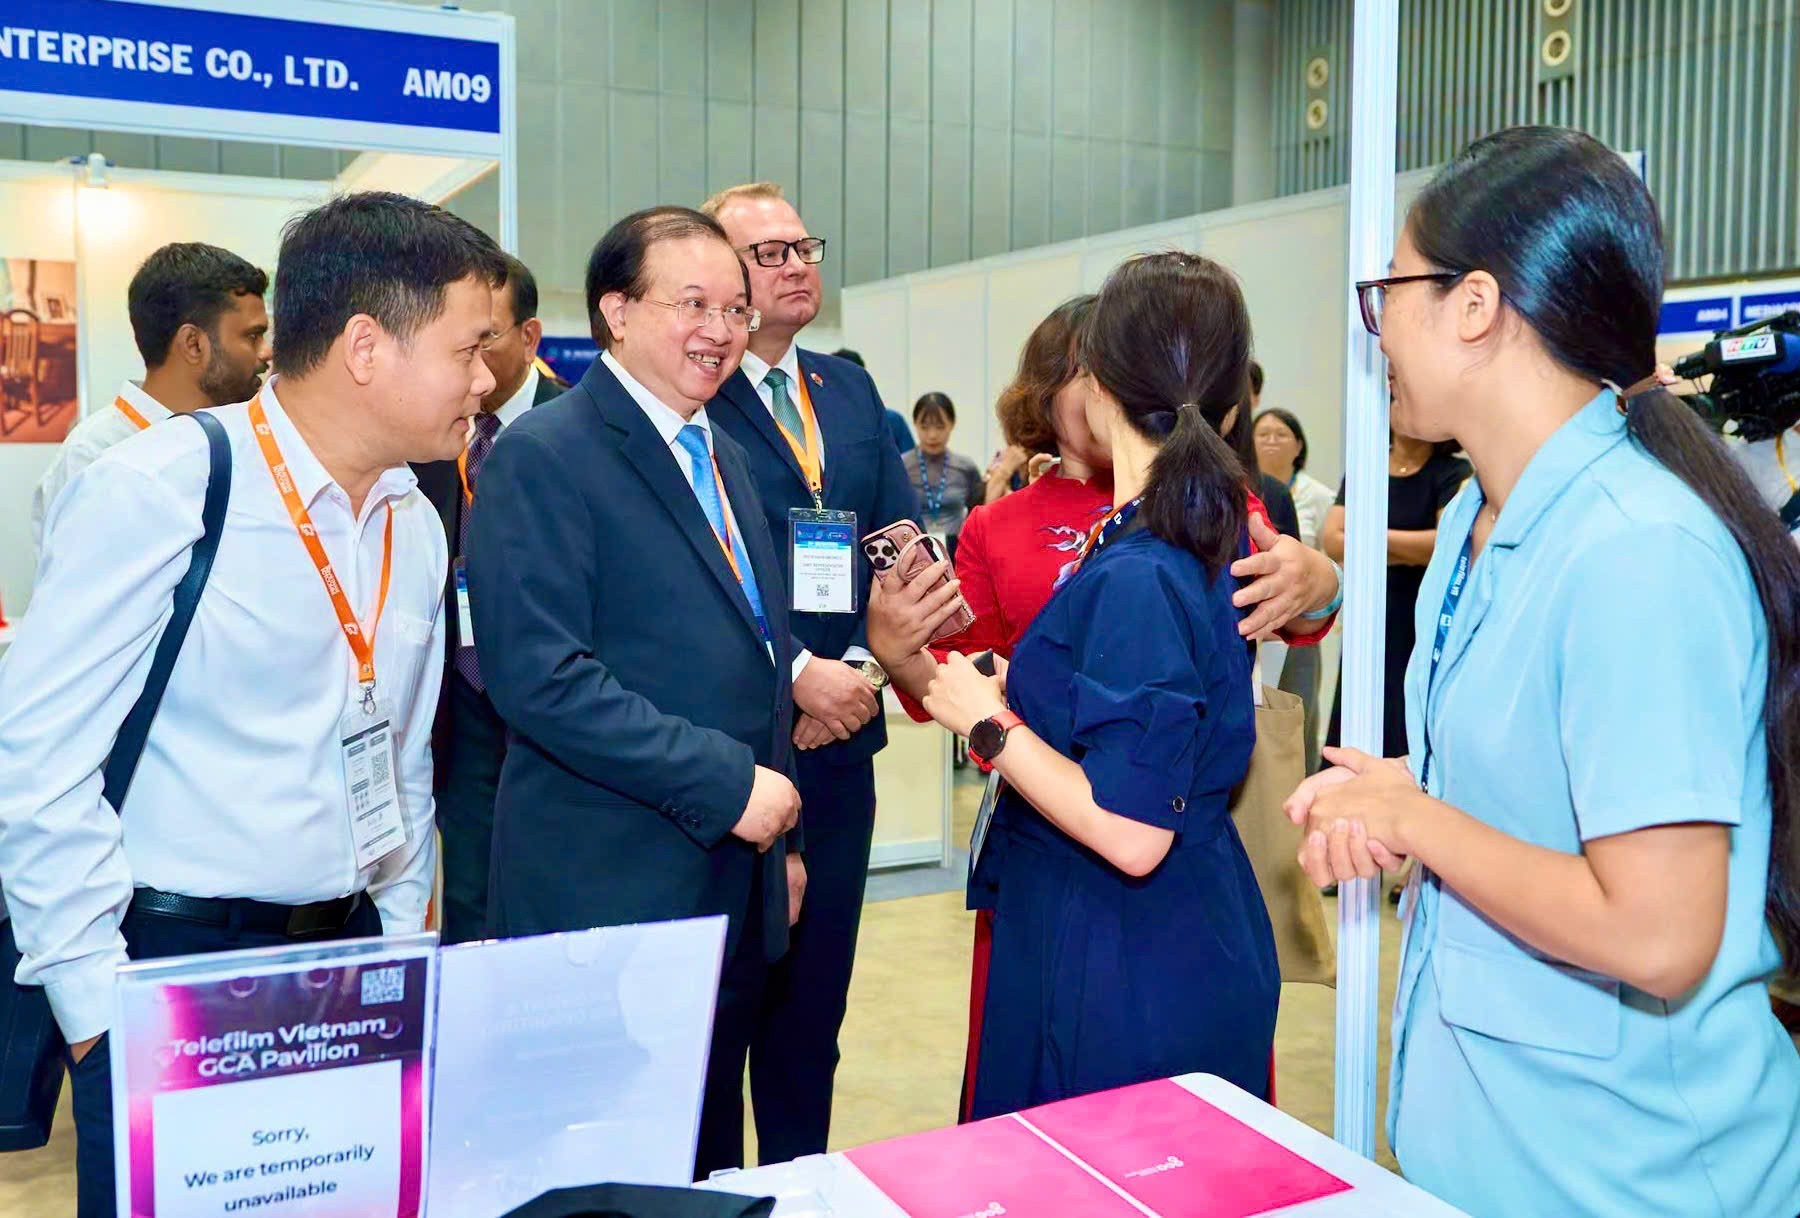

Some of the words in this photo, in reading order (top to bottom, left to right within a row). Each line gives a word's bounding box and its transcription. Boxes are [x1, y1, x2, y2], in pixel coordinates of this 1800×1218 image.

[205, 48, 273, 88] CO.,
[285, 56, 359, 91] LTD.
[403, 68, 491, 103] AM09
[171, 1030, 275, 1057] Telefilm
[278, 1017, 387, 1045] Vietnam
[198, 1056, 257, 1078] GCA
[260, 1042, 360, 1069] Pavilion
[251, 1127, 310, 1146] Sorry,
[183, 1171, 219, 1190] We
[222, 1167, 256, 1183] are
[259, 1144, 375, 1176] temporarily
[223, 1180, 338, 1212] unavailable
